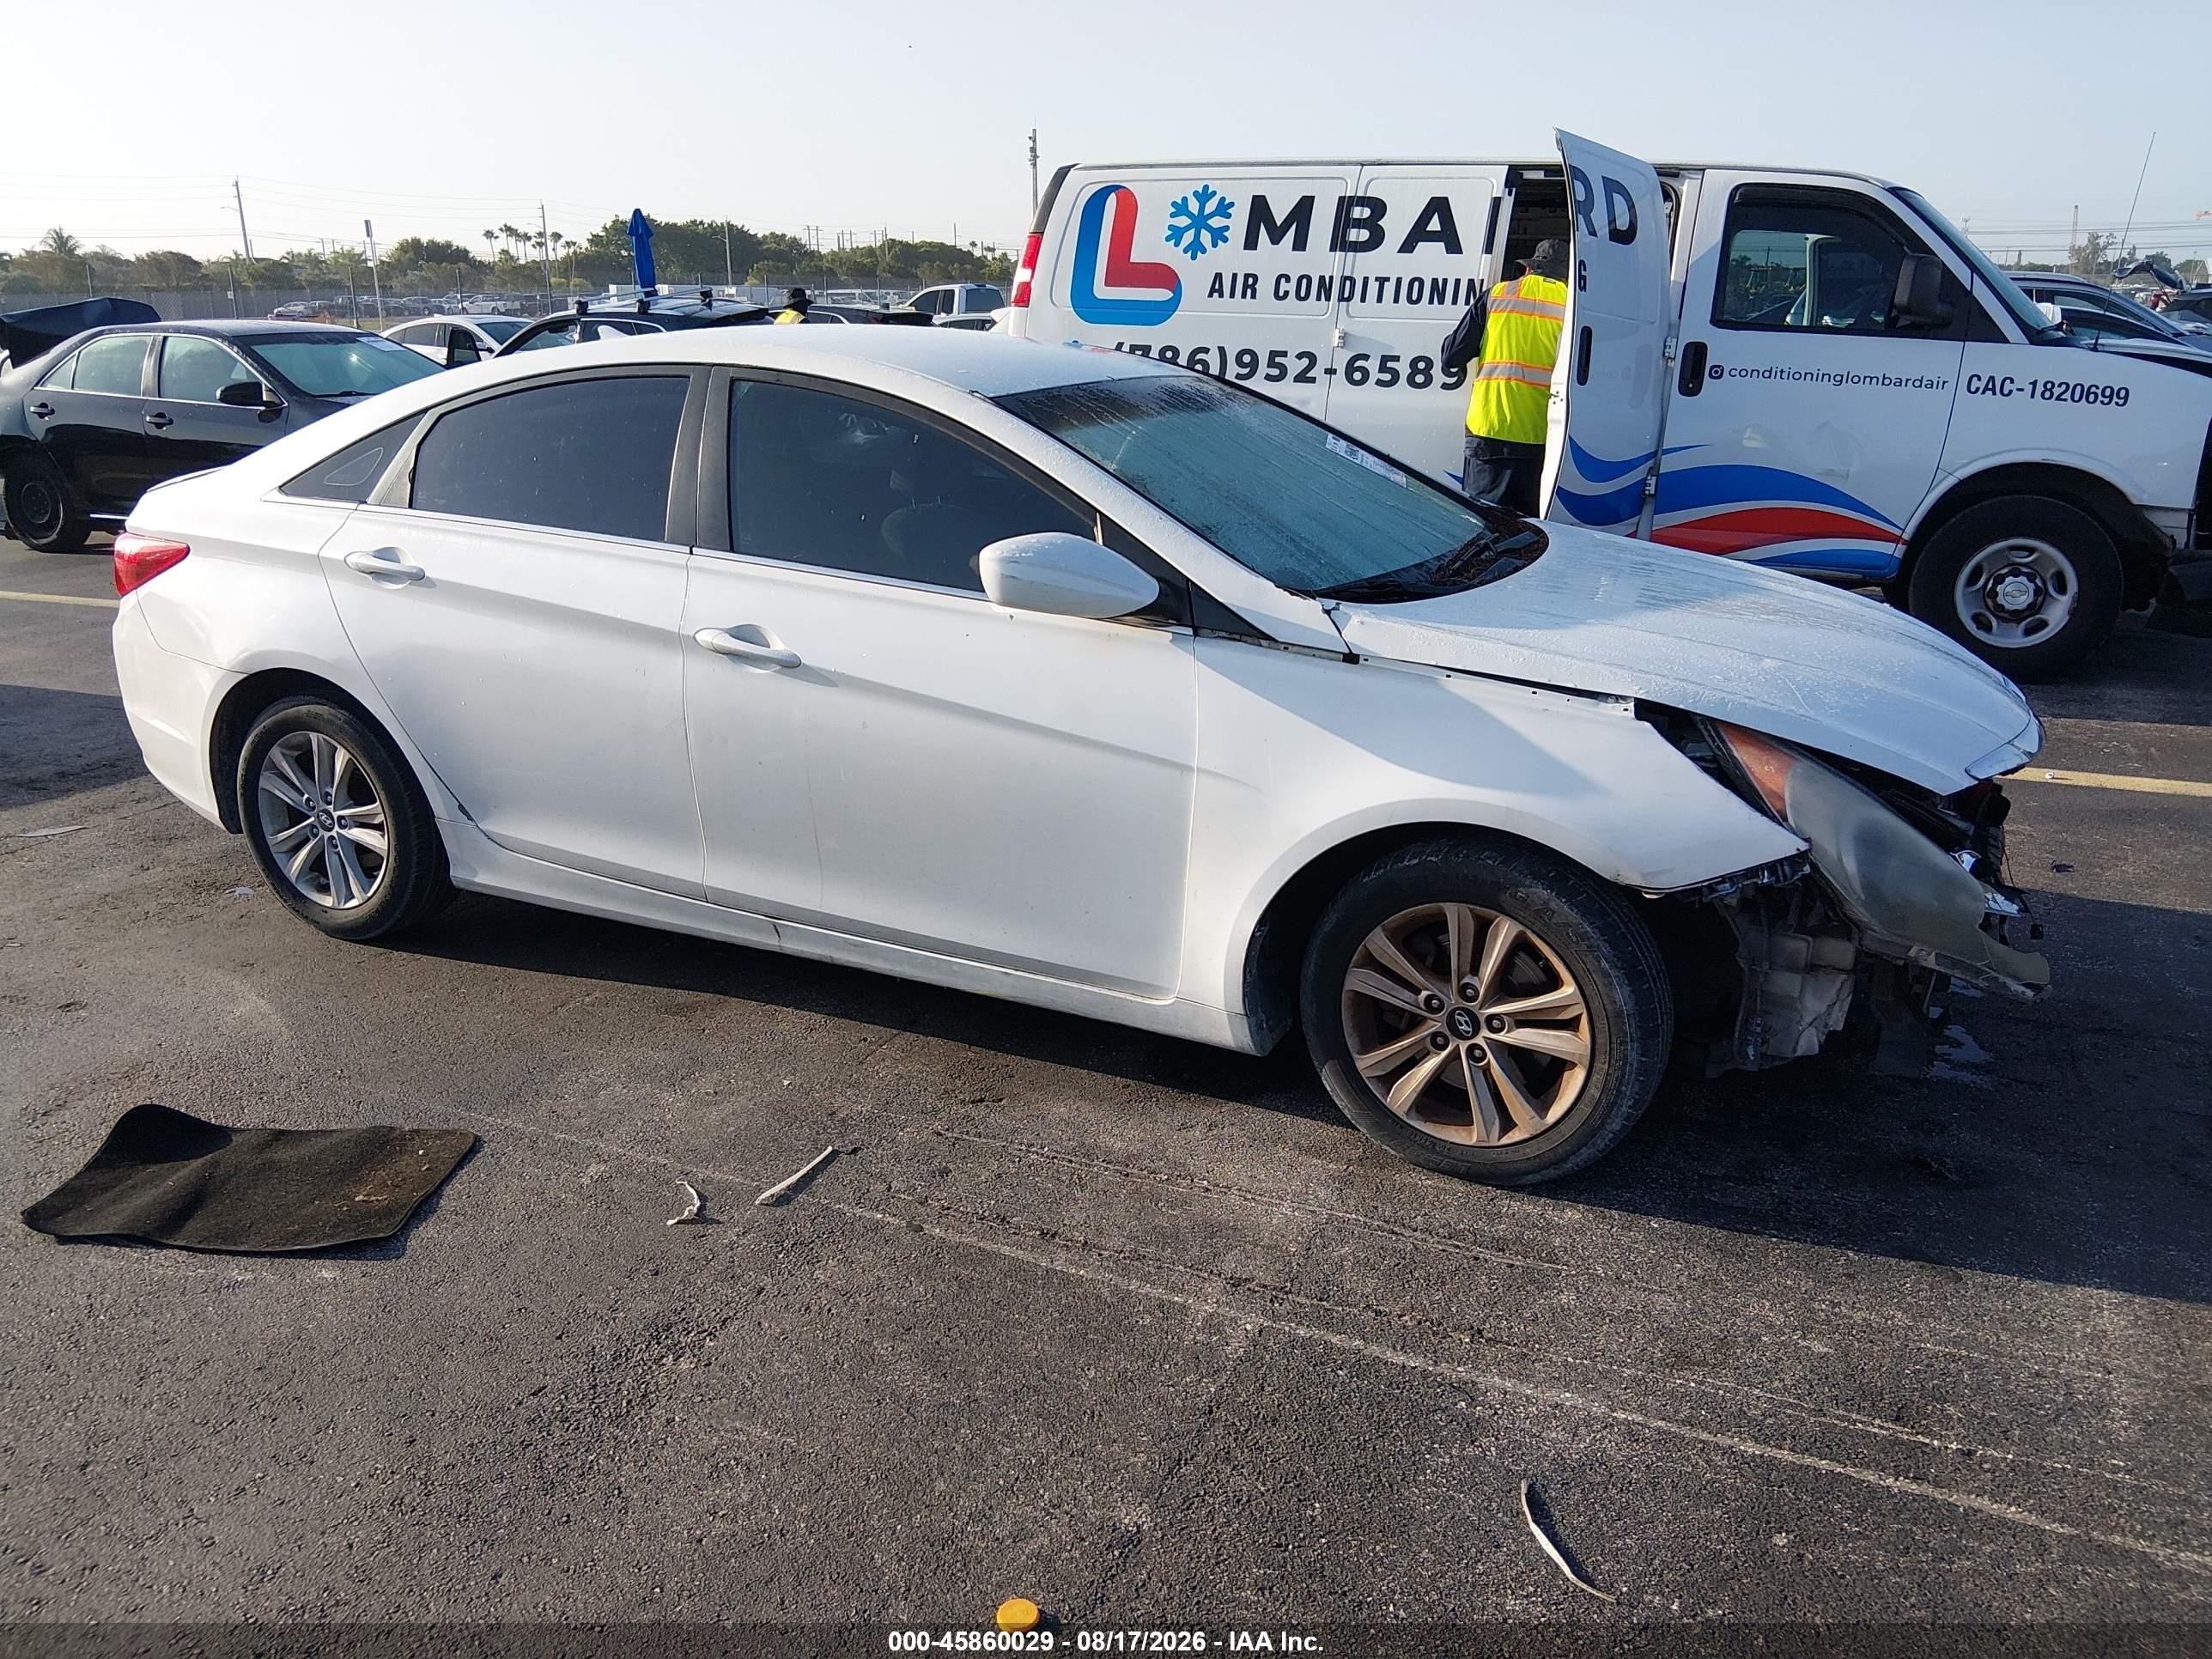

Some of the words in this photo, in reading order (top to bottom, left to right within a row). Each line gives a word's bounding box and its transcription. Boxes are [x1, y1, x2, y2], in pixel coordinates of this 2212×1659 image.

[1206, 271, 1259, 301] AIR
[1577, 259, 1588, 293] G
[1728, 365, 1950, 390] conditioninglombardair
[1966, 374, 2130, 407] CAC-1820699
